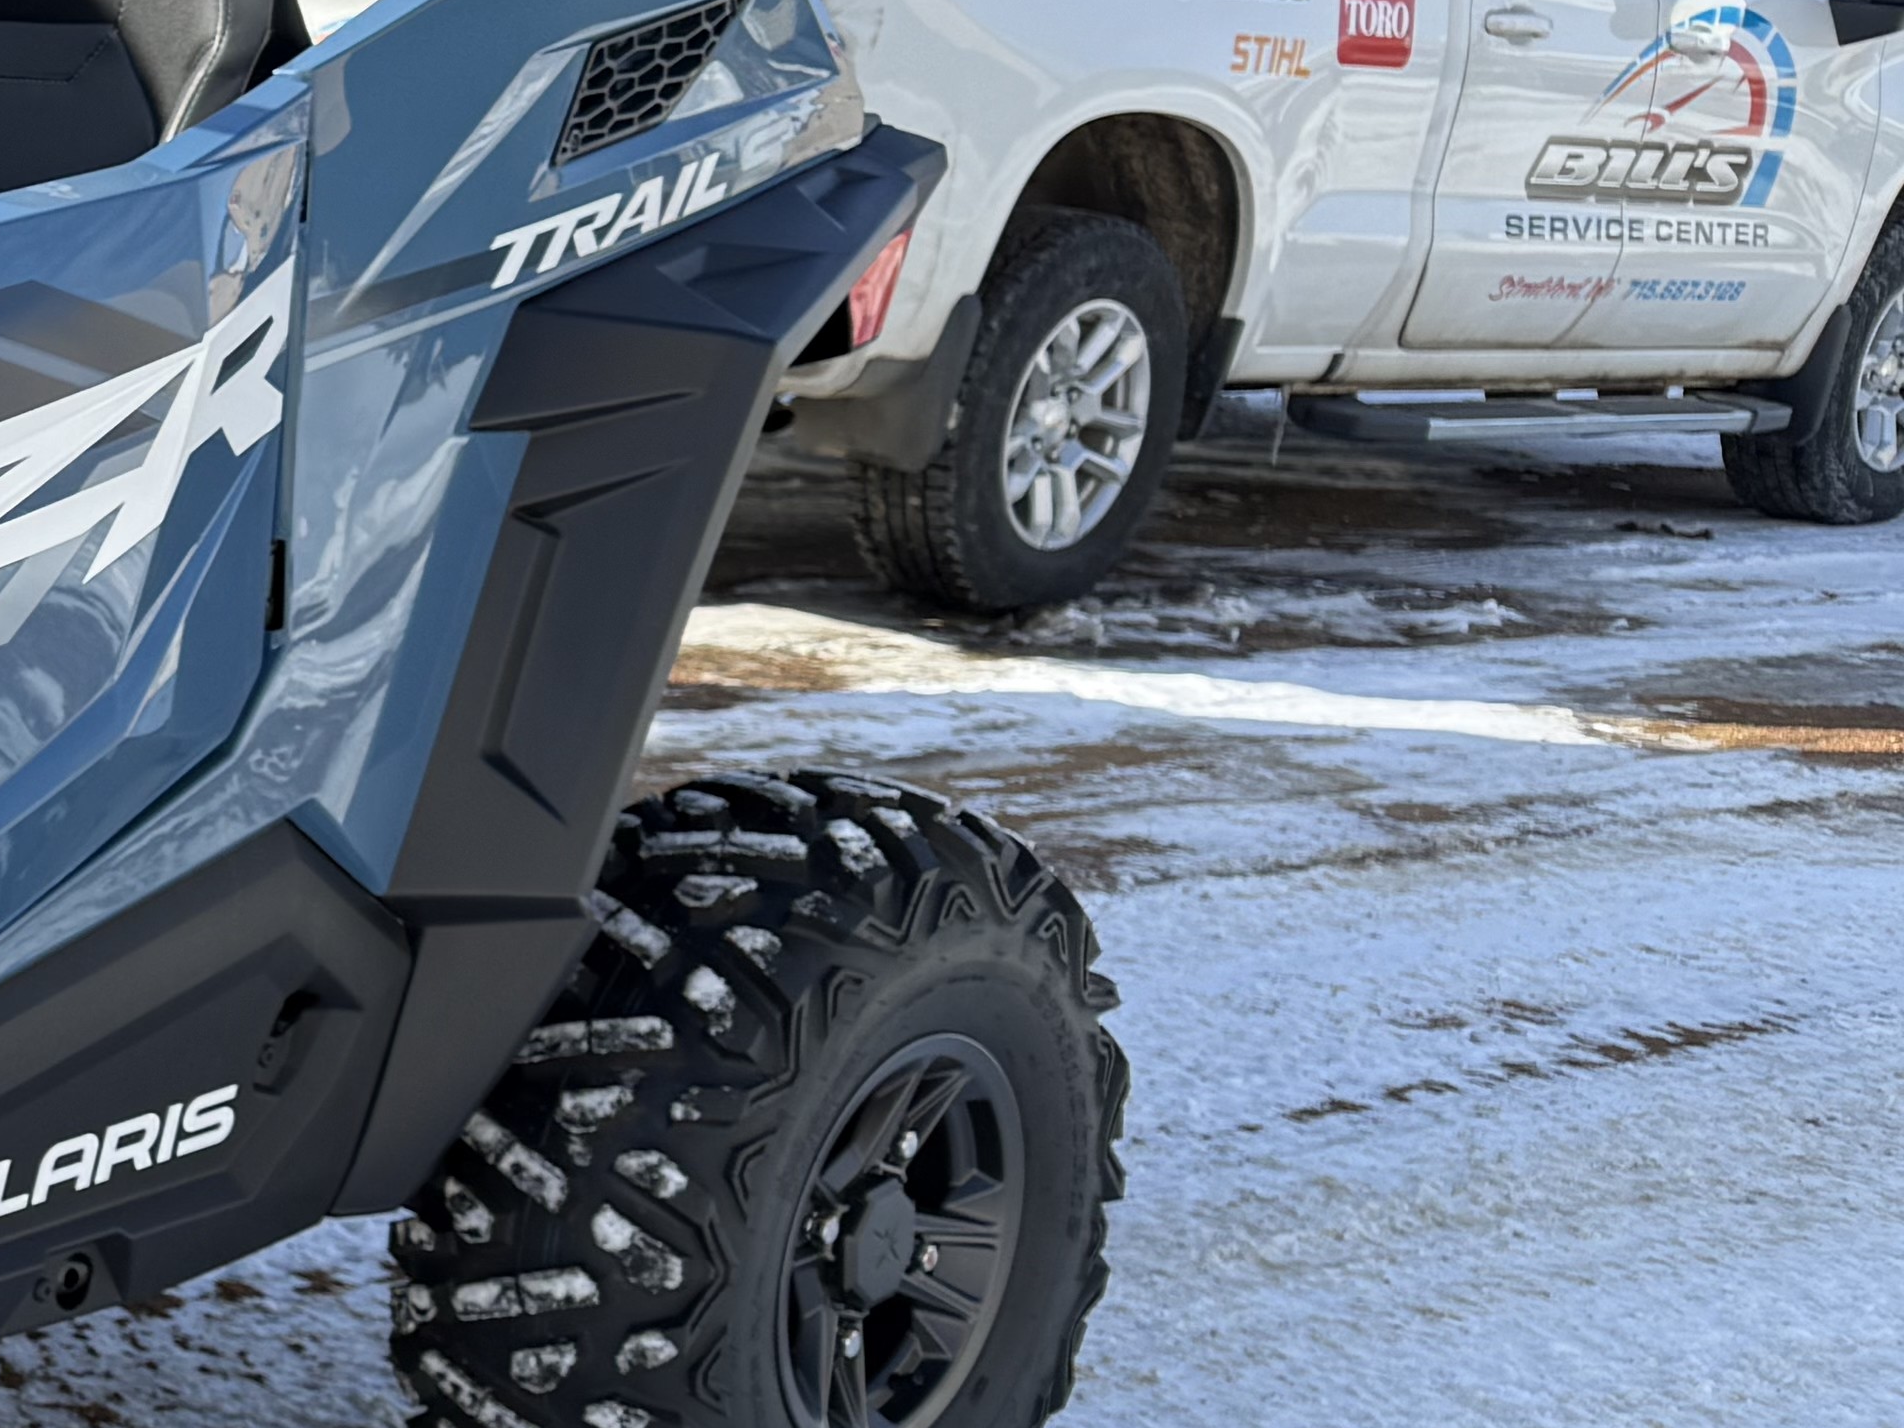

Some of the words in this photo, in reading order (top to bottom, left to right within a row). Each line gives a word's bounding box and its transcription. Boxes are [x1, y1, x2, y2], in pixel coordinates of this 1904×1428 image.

[1230, 33, 1311, 79] STIHL
[490, 151, 728, 290] TRAIL
[1505, 213, 1645, 243] SERVICE
[1655, 221, 1770, 247] CENTER
